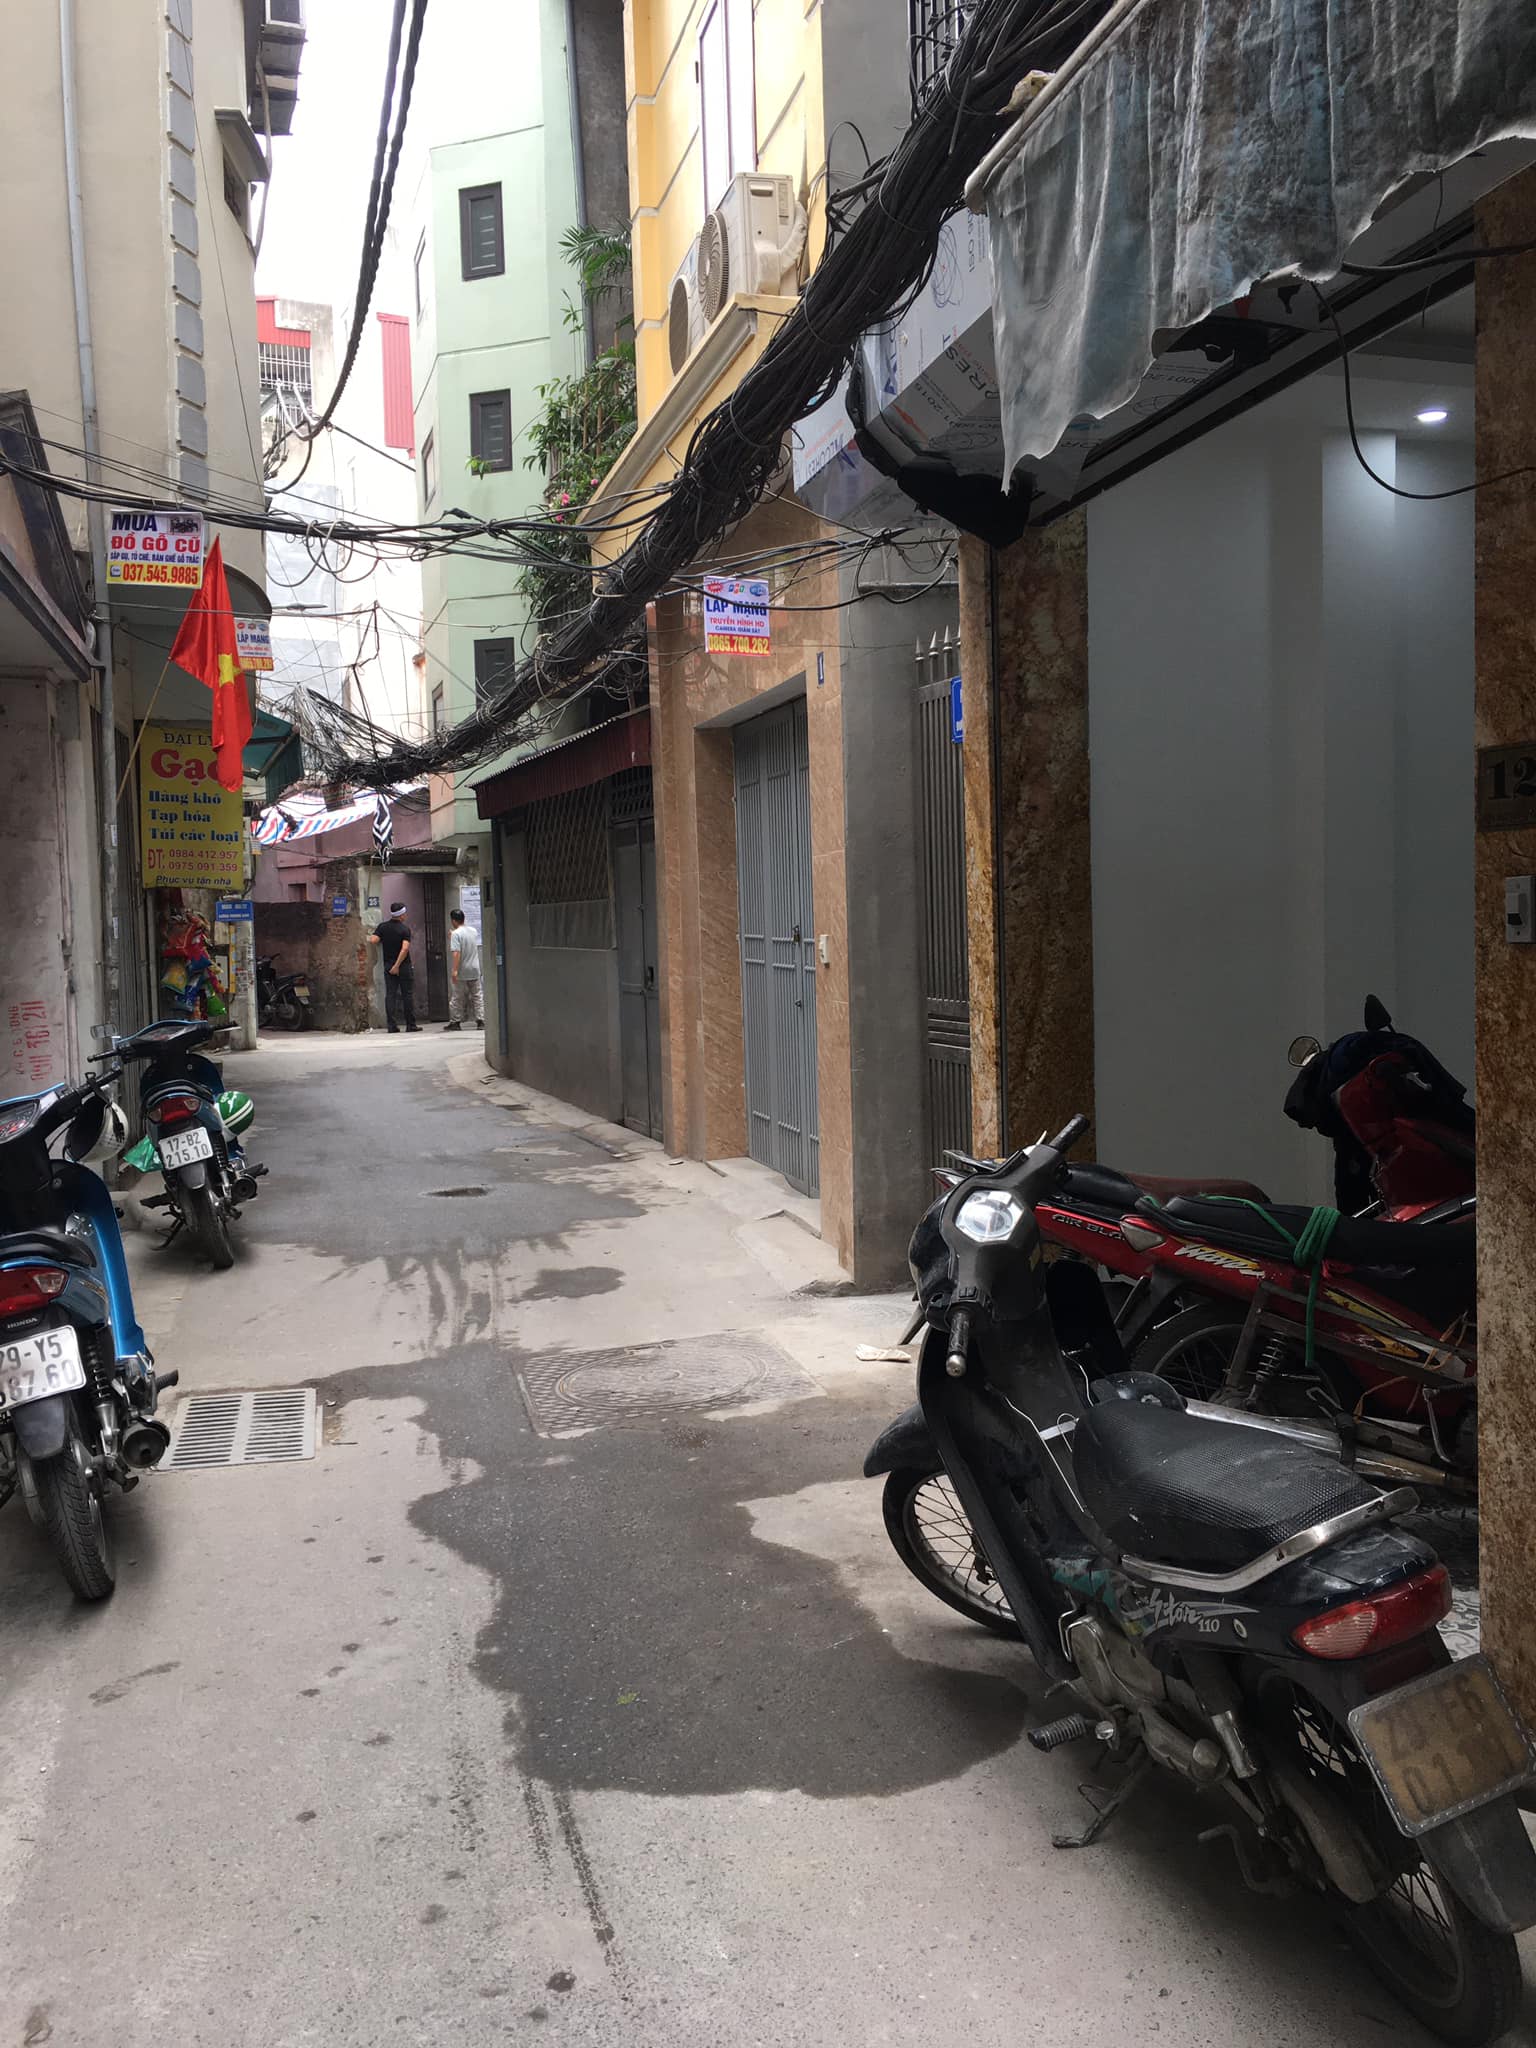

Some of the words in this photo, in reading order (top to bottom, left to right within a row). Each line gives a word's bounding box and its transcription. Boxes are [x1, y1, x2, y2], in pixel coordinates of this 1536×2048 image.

[111, 514, 158, 532] MUA
[111, 532, 136, 550] ĐỒ
[142, 533, 168, 552] GỖ
[175, 536, 200, 554] CŨ
[122, 563, 199, 585] 037.545.9885
[708, 634, 769, 654] 0865.700.262
[164, 733, 193, 748] ĐẠI
[148, 788, 189, 805] Hàng
[193, 791, 222, 804] khô
[149, 808, 179, 824] Tạp
[149, 827, 176, 840] Túi
[180, 828, 206, 841] các
[210, 830, 239, 845] loại
[167, 1132, 202, 1152] 17-B2
[165, 1143, 210, 1168] 215.10
[1051, 1213, 1083, 1228] AIR
[7, 1317, 39, 1329] HONDA
[1198, 1619, 1220, 1633] 110
